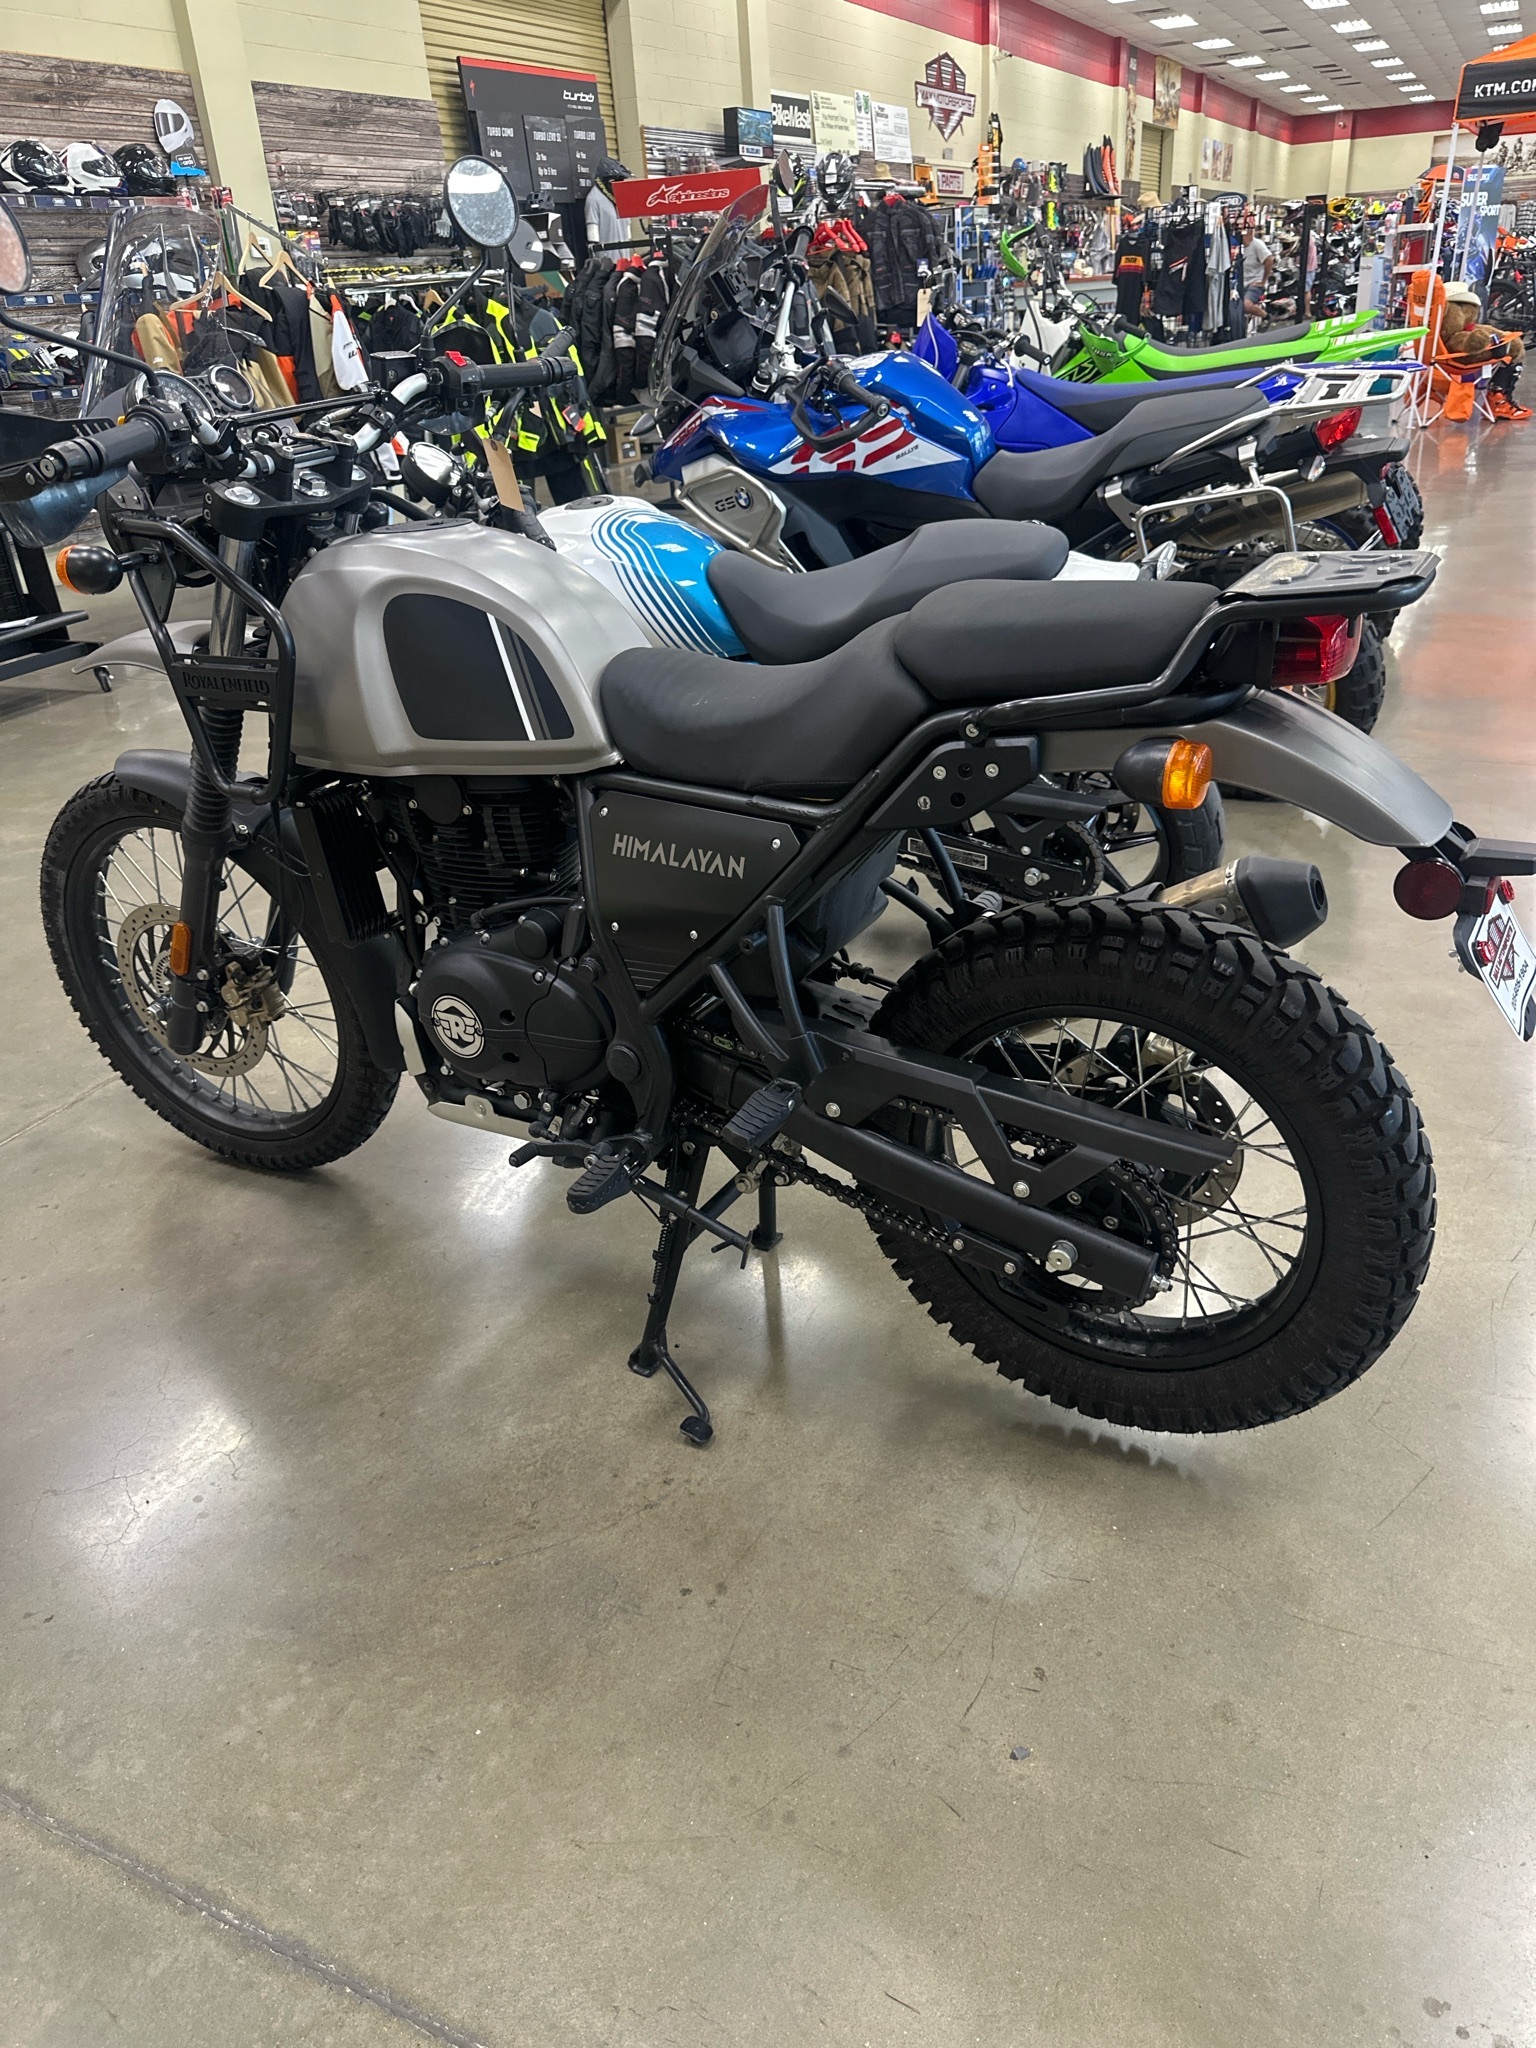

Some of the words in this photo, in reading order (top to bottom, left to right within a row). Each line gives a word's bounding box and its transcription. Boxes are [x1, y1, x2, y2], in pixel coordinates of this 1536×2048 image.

[563, 90, 595, 103] turbo
[941, 174, 961, 190] PARTS
[669, 188, 730, 205] alpinestars
[1461, 191, 1488, 207] SUER
[1479, 204, 1501, 217] SPORT
[715, 497, 736, 513] GS
[182, 671, 220, 690] ROYAL
[220, 677, 271, 697] ENFIELD
[612, 833, 746, 880] HIMALAYAN
